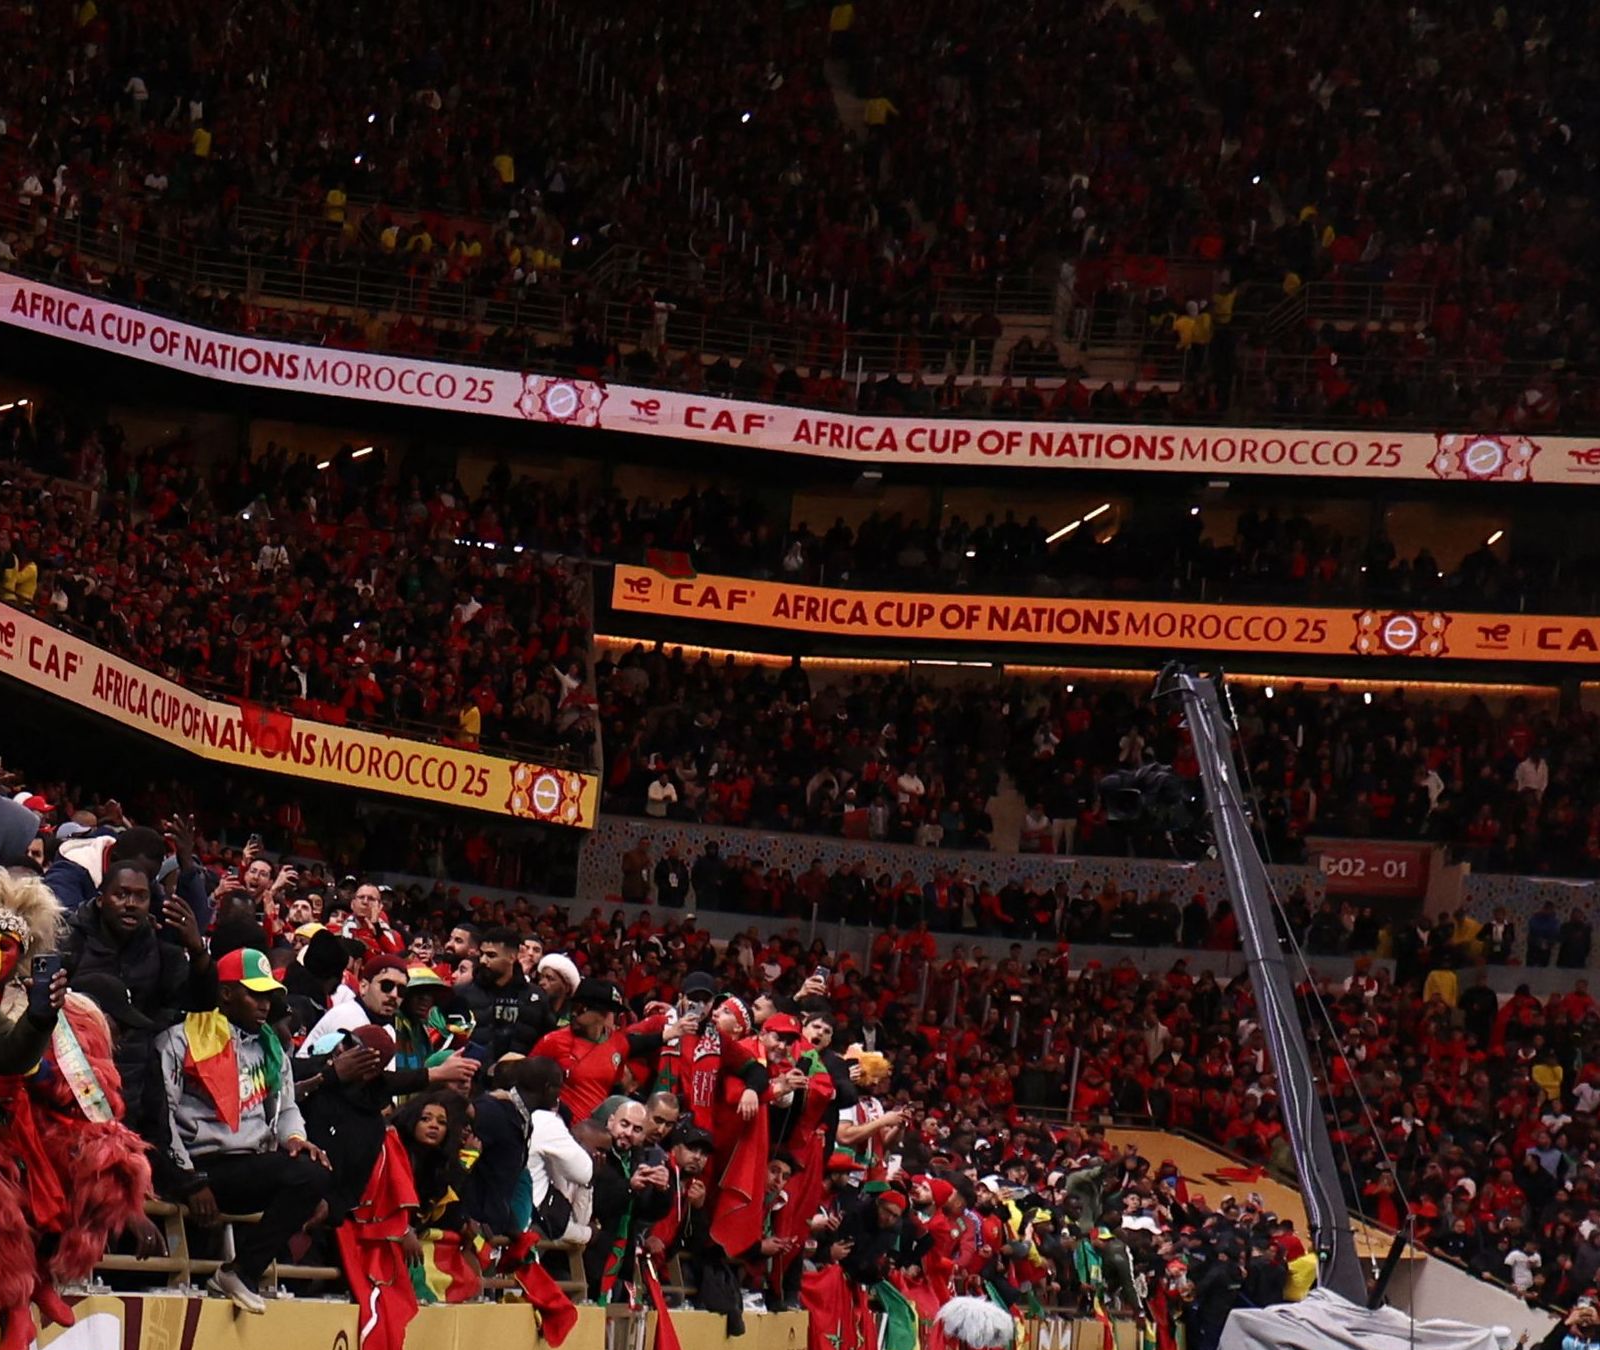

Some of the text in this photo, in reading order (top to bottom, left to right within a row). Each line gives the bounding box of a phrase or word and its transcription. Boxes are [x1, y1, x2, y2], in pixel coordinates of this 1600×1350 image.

[10, 288, 96, 336] AFRICA
[100, 312, 146, 347] CUP
[150, 326, 180, 357] OF
[183, 335, 300, 381] NATIONS
[303, 357, 458, 400] MOROCCO
[463, 377, 495, 404] 25
[683, 406, 766, 435] CAF
[792, 418, 898, 452] AFRICA
[905, 427, 971, 454] CUP
[977, 429, 1023, 456] OF
[1029, 431, 1175, 461] NATIONS
[1179, 436, 1359, 467] MOROCCO
[1365, 442, 1403, 468] 25
[672, 582, 748, 611] CAF
[772, 592, 869, 626] AFRICA
[874, 600, 936, 629] CUP
[940, 603, 983, 630] OF
[987, 605, 1121, 637] NATIONS
[1124, 611, 1288, 643] MOROCCO
[1293, 618, 1328, 644] 25
[1537, 627, 1600, 652] CA
[28, 635, 79, 683] CAF
[92, 662, 149, 720] AFRICA
[150, 688, 181, 731] CUP
[181, 703, 203, 742] OF
[319, 737, 458, 792] MOROCCO
[461, 764, 491, 798] 25
